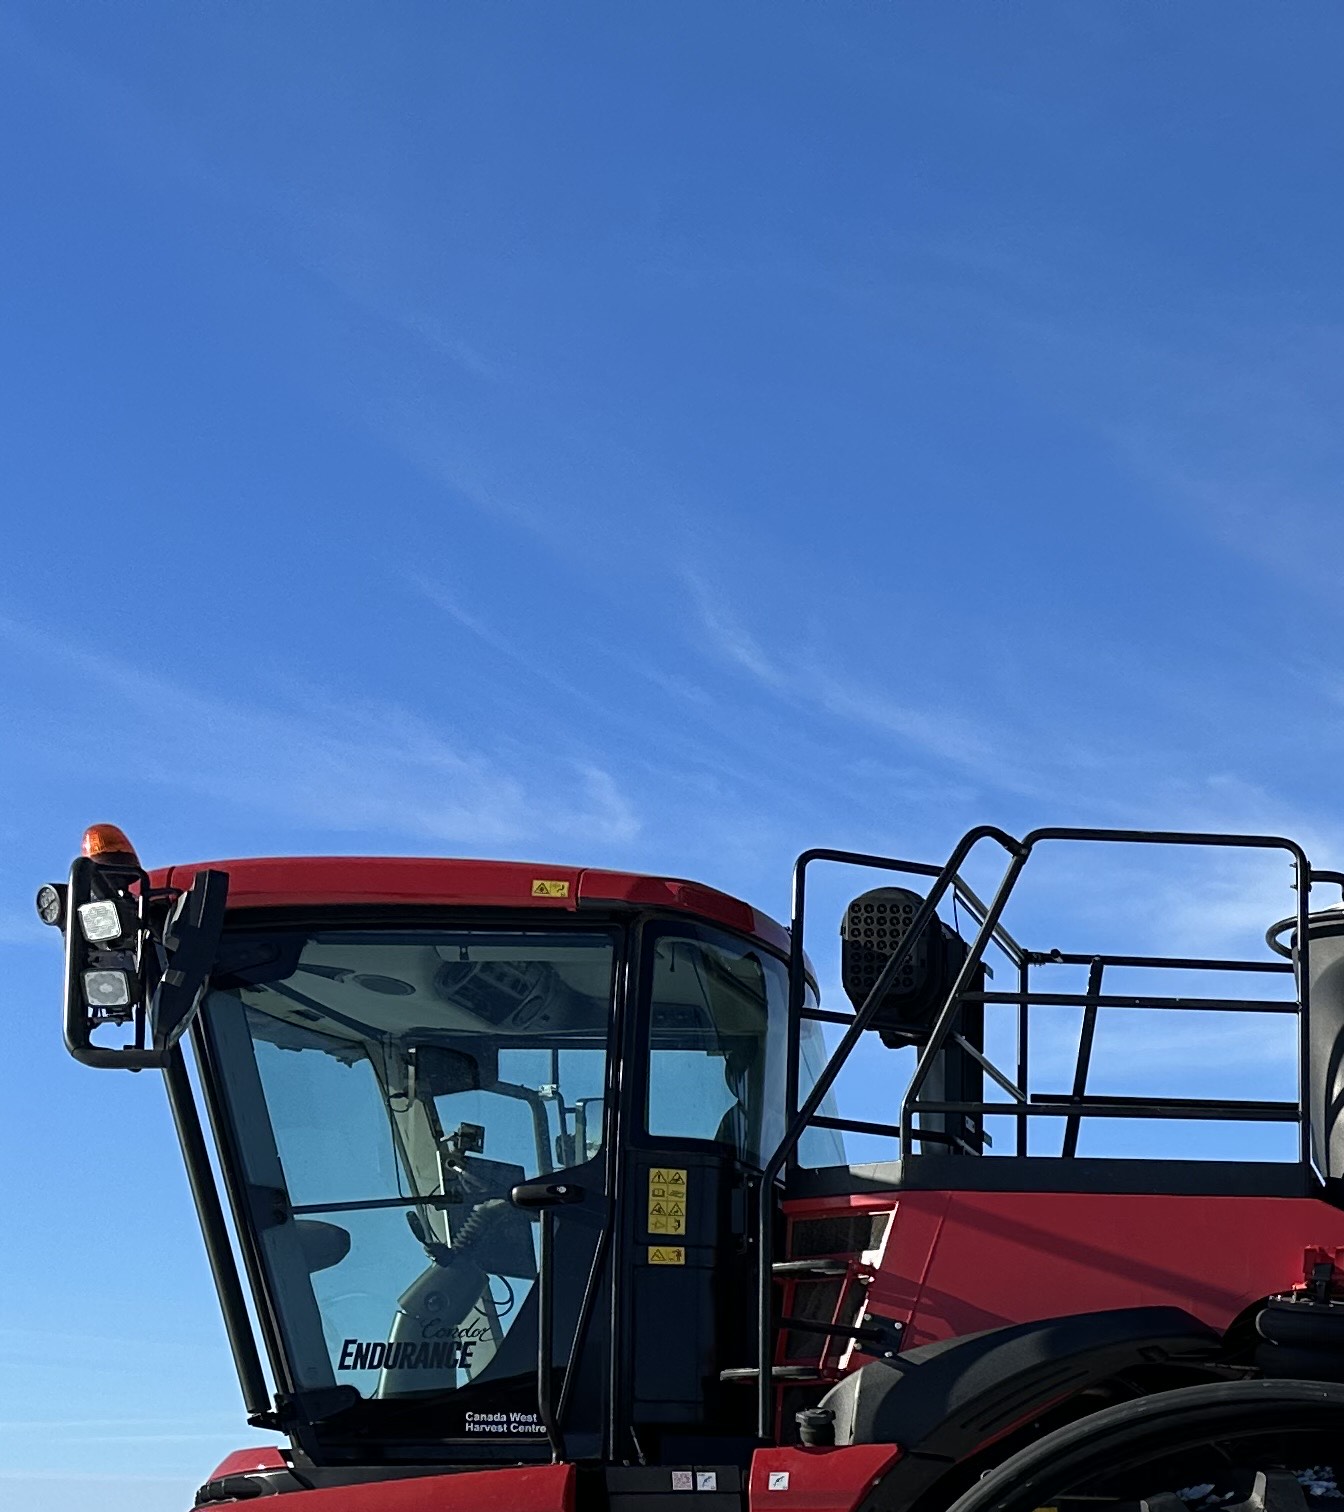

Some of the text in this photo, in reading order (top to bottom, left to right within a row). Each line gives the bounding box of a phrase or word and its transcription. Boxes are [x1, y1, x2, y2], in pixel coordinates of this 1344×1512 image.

[420, 1317, 497, 1342] Condor
[338, 1338, 477, 1371] ENDURANCE
[465, 1411, 538, 1423] Canada West
[465, 1422, 547, 1433] Harvest Centre
